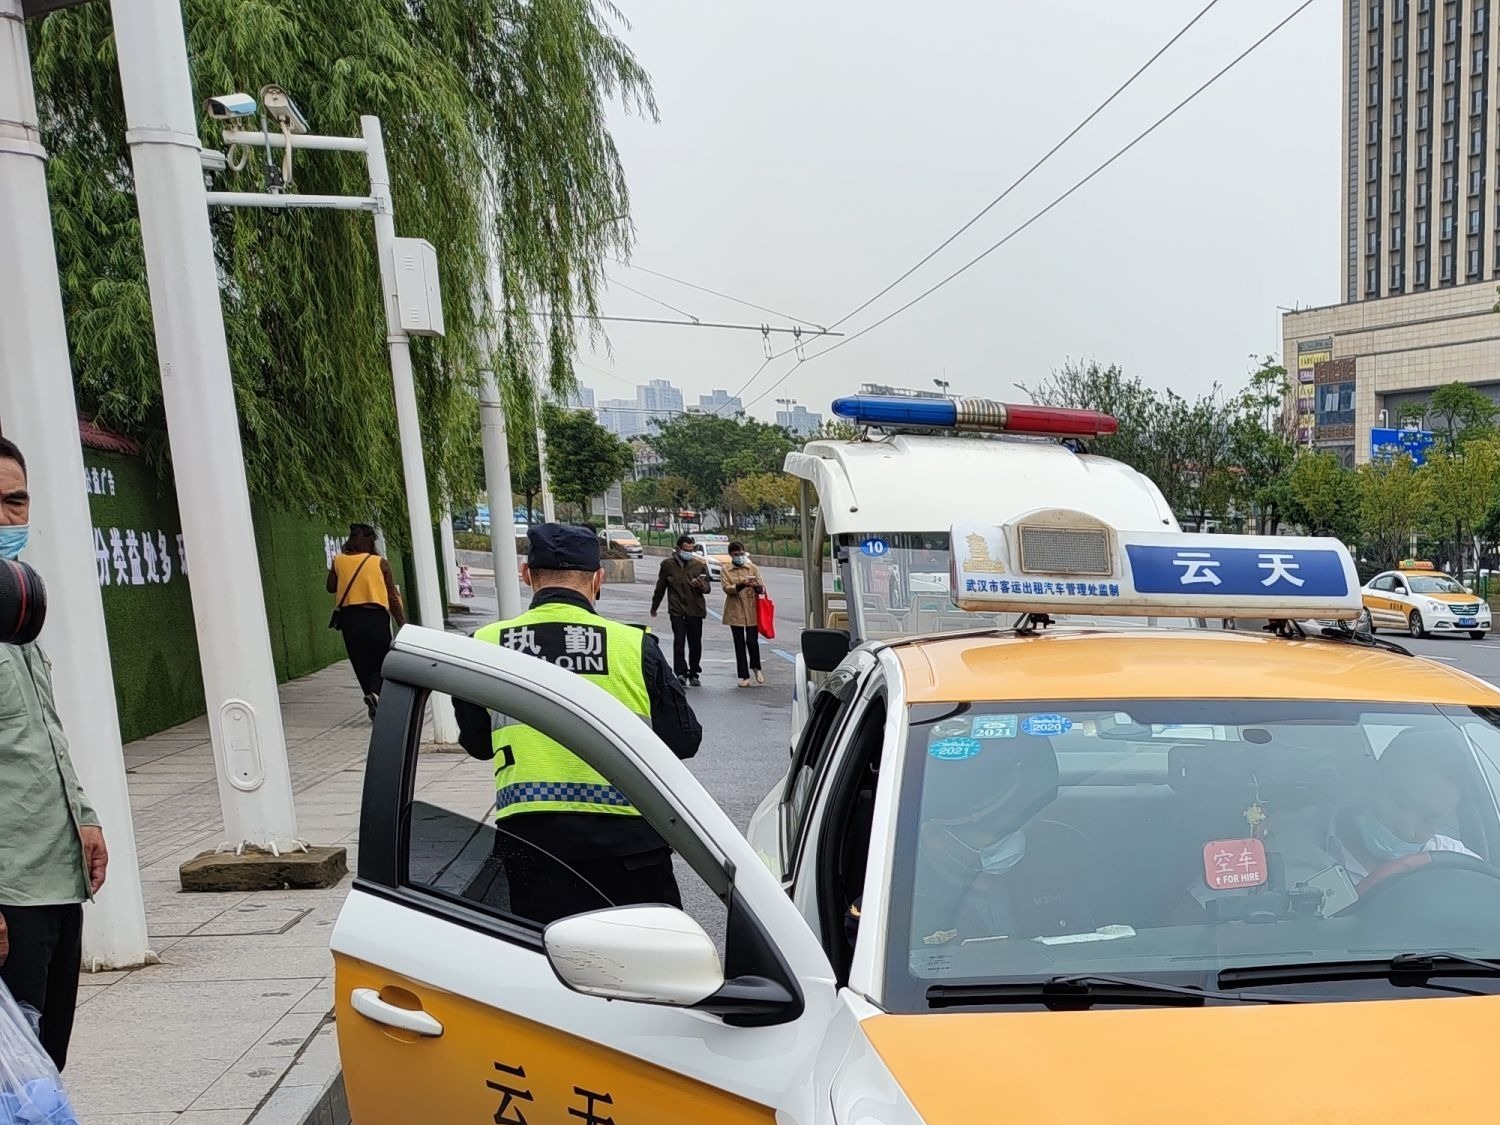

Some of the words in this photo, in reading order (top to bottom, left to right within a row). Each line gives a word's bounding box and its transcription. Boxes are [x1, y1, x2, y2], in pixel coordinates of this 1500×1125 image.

[866, 541, 883, 554] 10
[94, 527, 171, 586] 分类益处多
[1172, 552, 1306, 587] 云天
[965, 579, 1120, 598] 武汉市客运出租汽车管理处监制
[503, 624, 603, 656] 执勤
[975, 728, 1012, 737] 2021
[1032, 723, 1062, 732] 2020
[938, 746, 969, 756] 2021
[1213, 847, 1258, 874] 空车
[1223, 874, 1240, 884] FOR
[1241, 872, 1260, 882] HIRE
